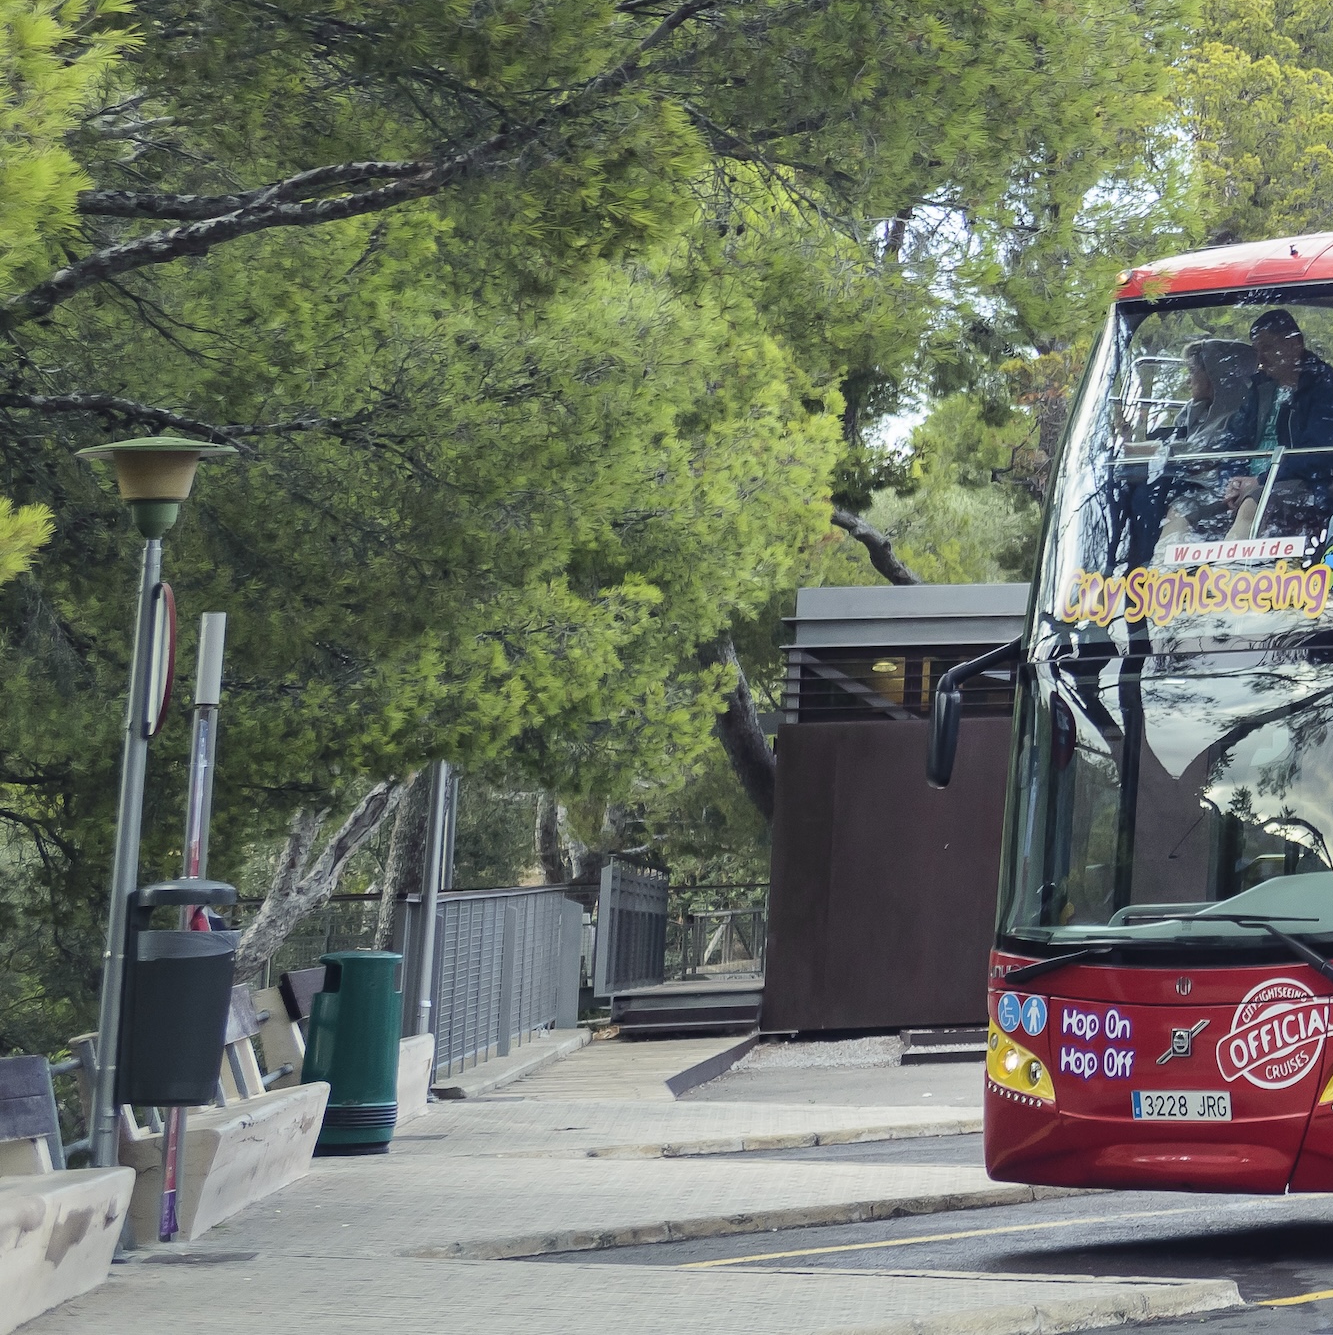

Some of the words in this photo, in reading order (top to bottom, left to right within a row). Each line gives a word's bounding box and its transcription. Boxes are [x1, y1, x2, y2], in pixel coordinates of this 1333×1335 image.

[1174, 541, 1295, 562] Worldwide
[1242, 986, 1308, 1024] CITYSIGHTSEEING
[1062, 1008, 1099, 1041] Hop
[1105, 1009, 1131, 1040] On
[1060, 1046, 1098, 1079] Hop
[1103, 1047, 1135, 1078] Off
[1265, 1050, 1310, 1080] CRUISES
[1144, 1094, 1189, 1118] 3228
[1196, 1094, 1228, 1118] JRG
